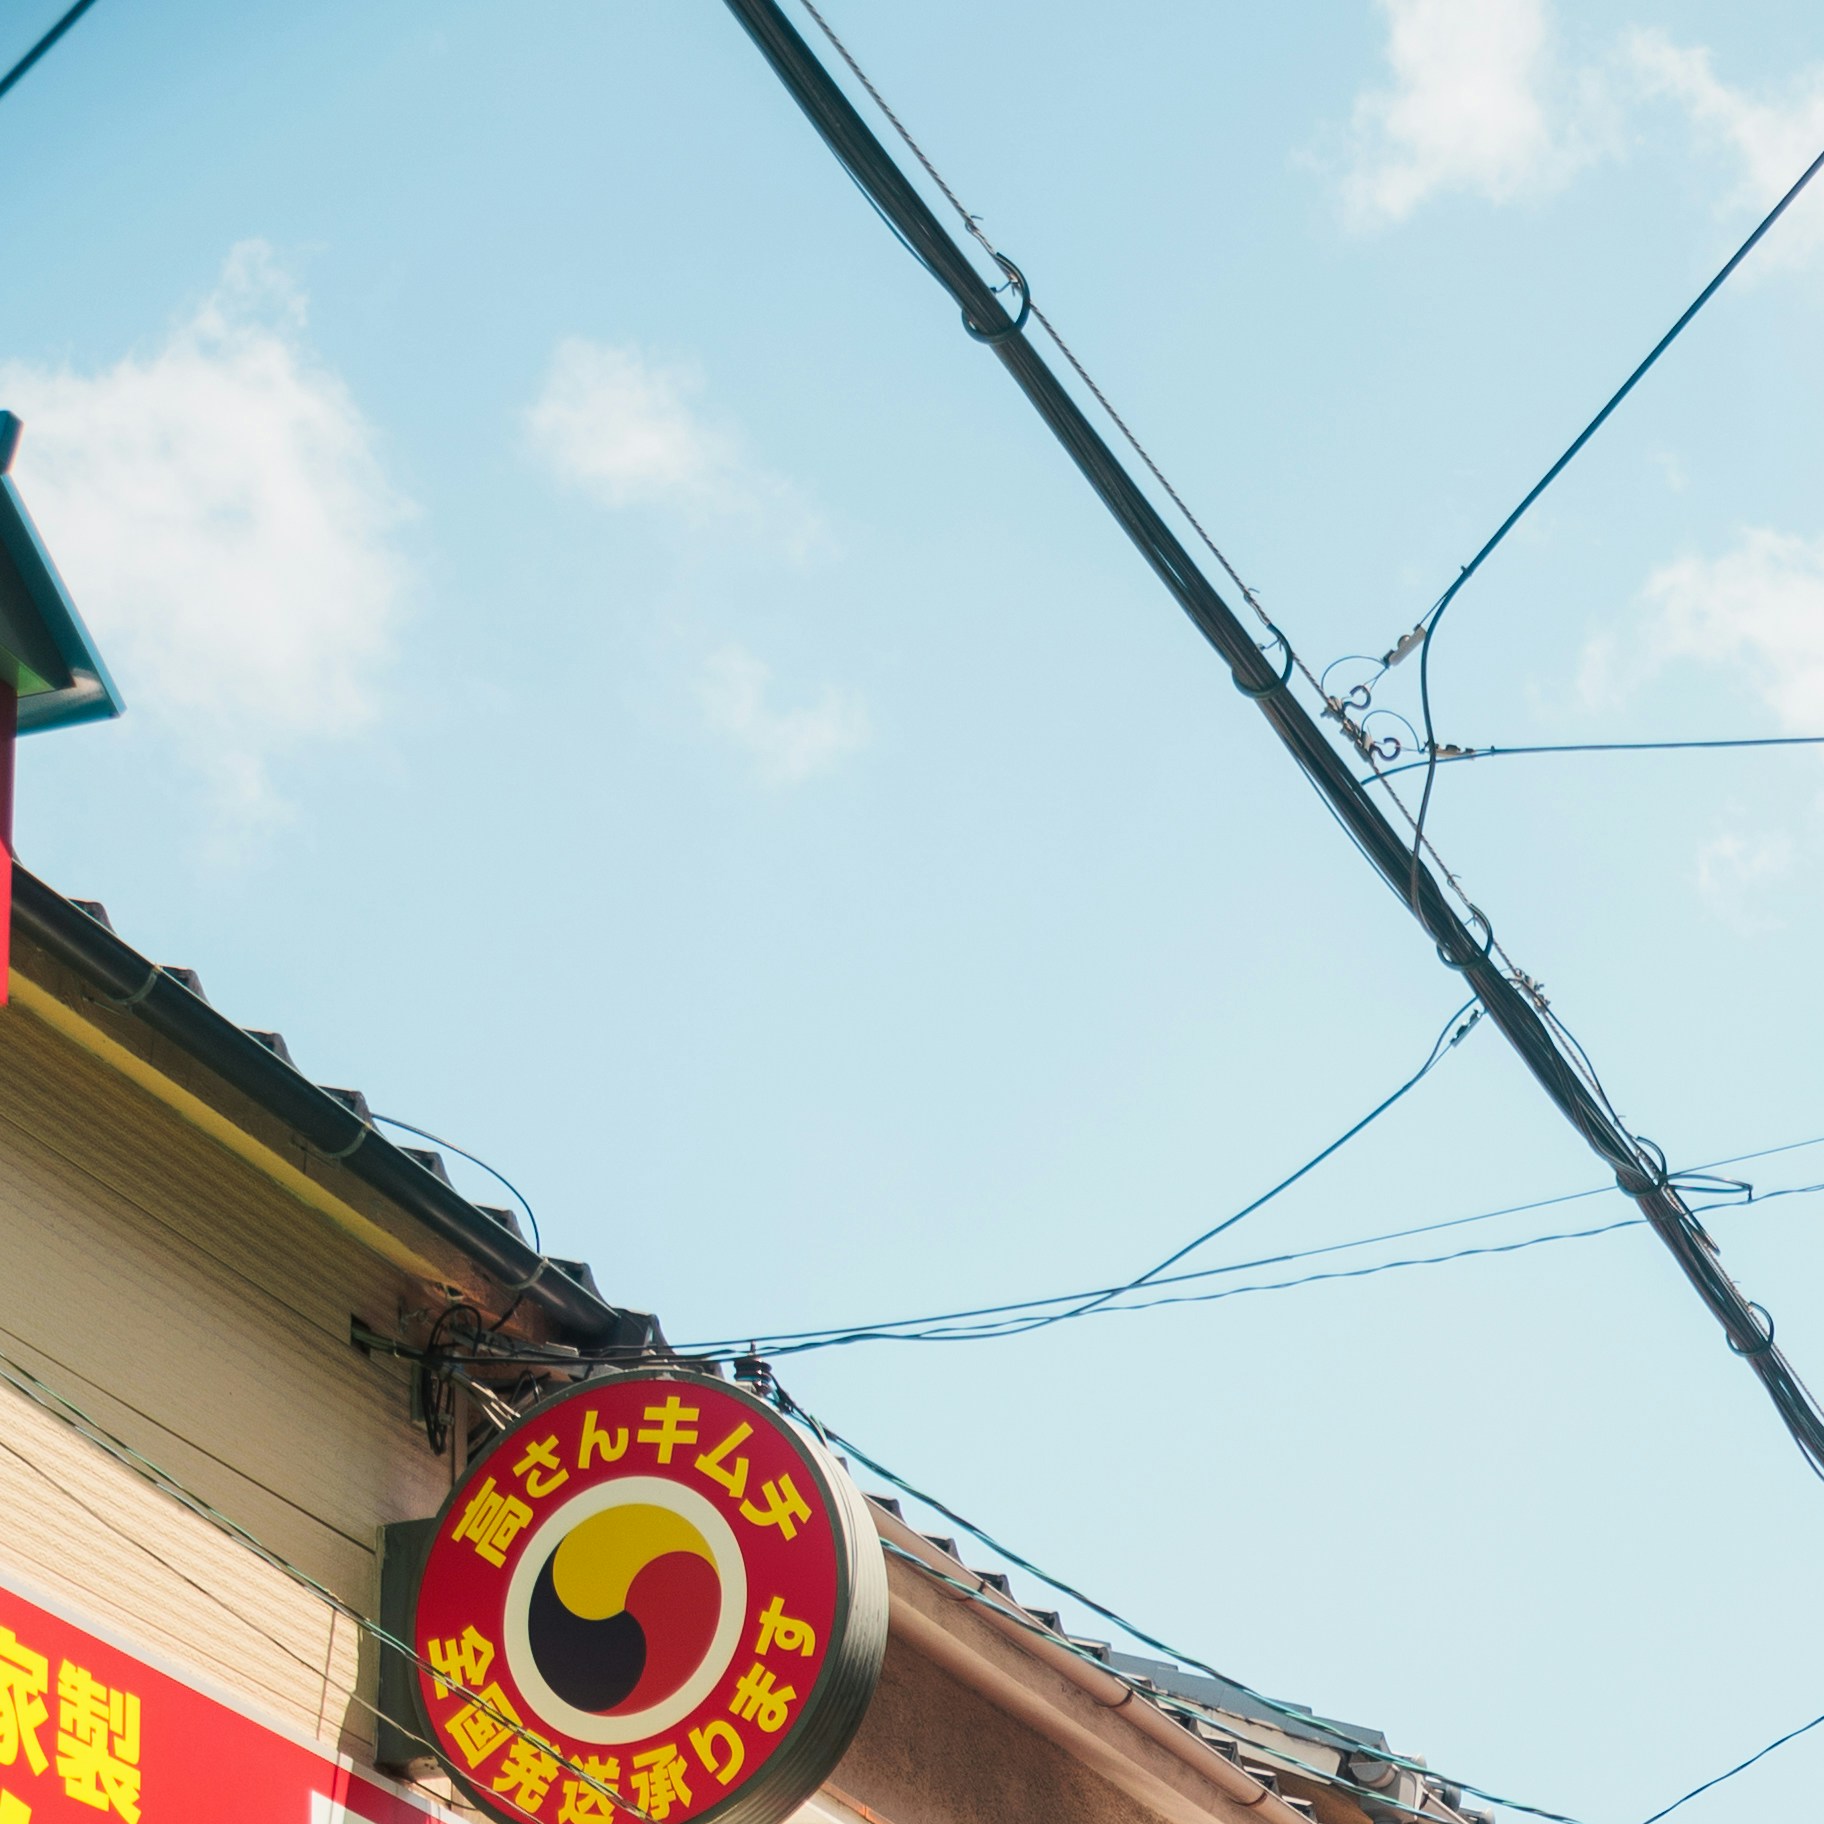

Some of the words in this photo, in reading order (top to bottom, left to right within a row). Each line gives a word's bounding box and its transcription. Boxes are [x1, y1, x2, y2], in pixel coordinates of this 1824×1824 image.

[452, 1397, 811, 1567] 高さんキムチ
